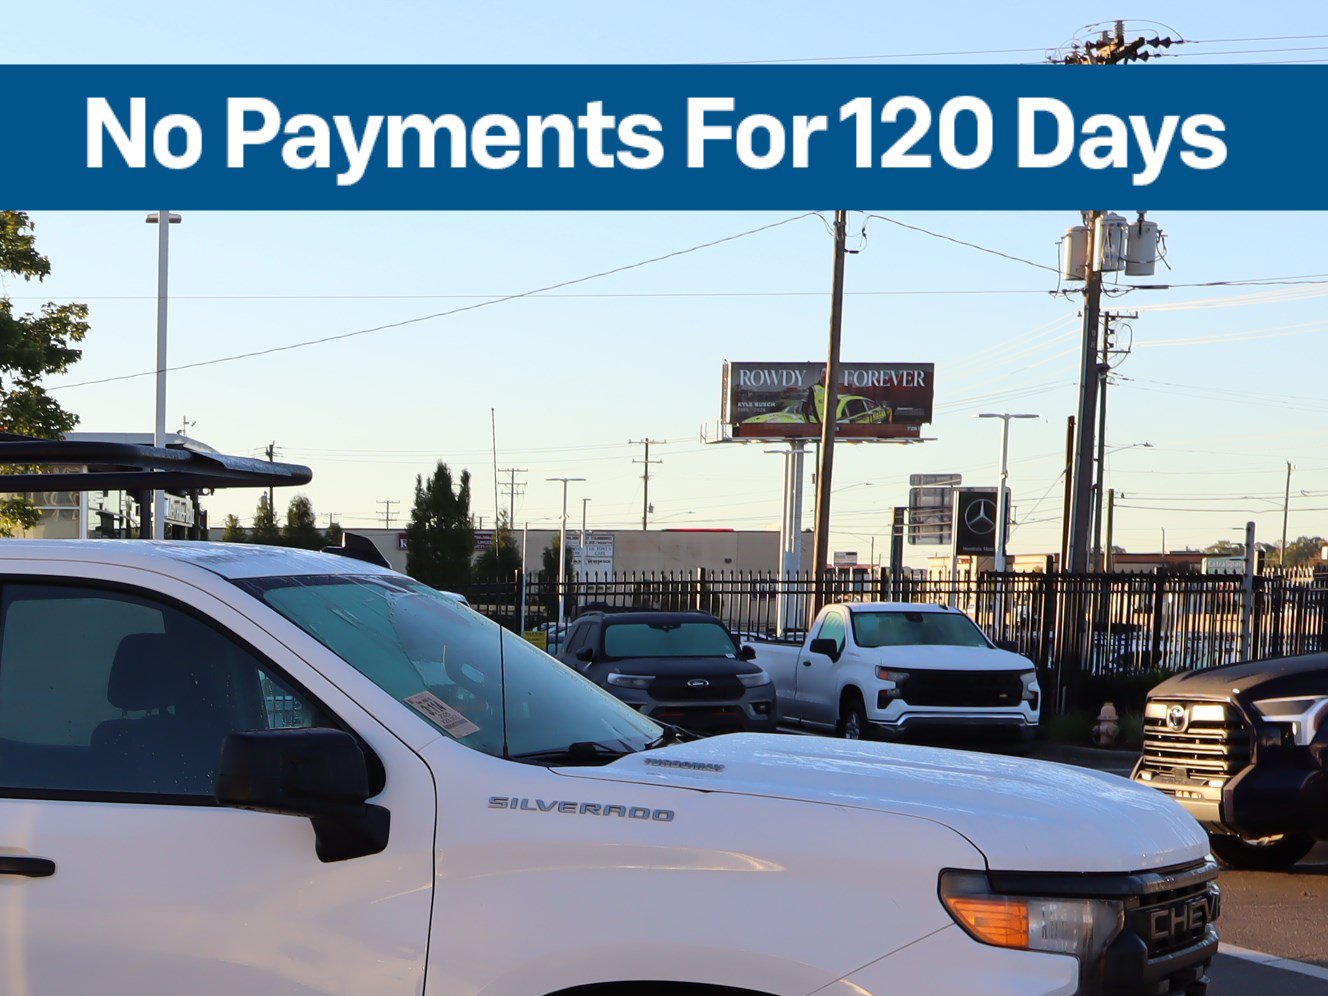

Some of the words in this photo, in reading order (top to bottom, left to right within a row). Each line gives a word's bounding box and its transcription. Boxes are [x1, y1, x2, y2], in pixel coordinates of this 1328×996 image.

[739, 369, 806, 387] ROWDY
[843, 369, 926, 387] FOREVER
[487, 796, 675, 822] SILVERADO
